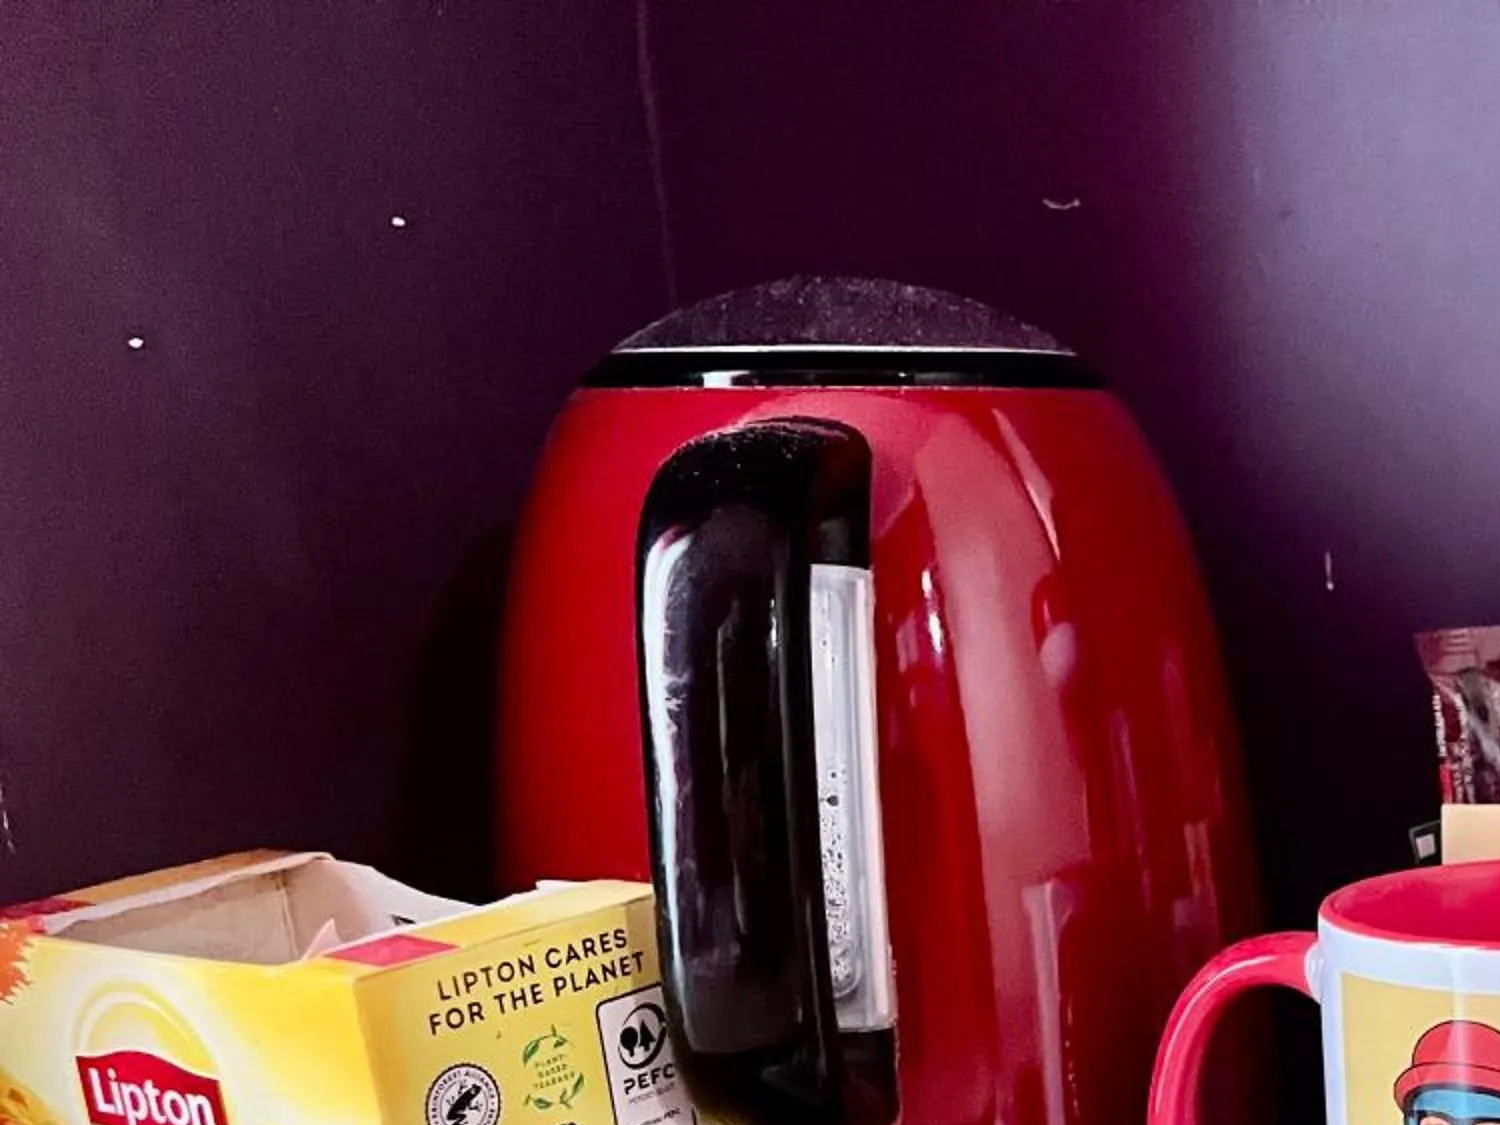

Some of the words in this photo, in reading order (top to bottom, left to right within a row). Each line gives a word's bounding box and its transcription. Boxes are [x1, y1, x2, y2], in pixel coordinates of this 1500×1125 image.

[428, 1001, 485, 1036] FOR
[493, 983, 544, 1014] THE
[553, 951, 644, 997] PLANET
[437, 953, 536, 1001] LIPTON
[545, 928, 628, 968] CARES
[623, 1063, 676, 1095] PEFC
